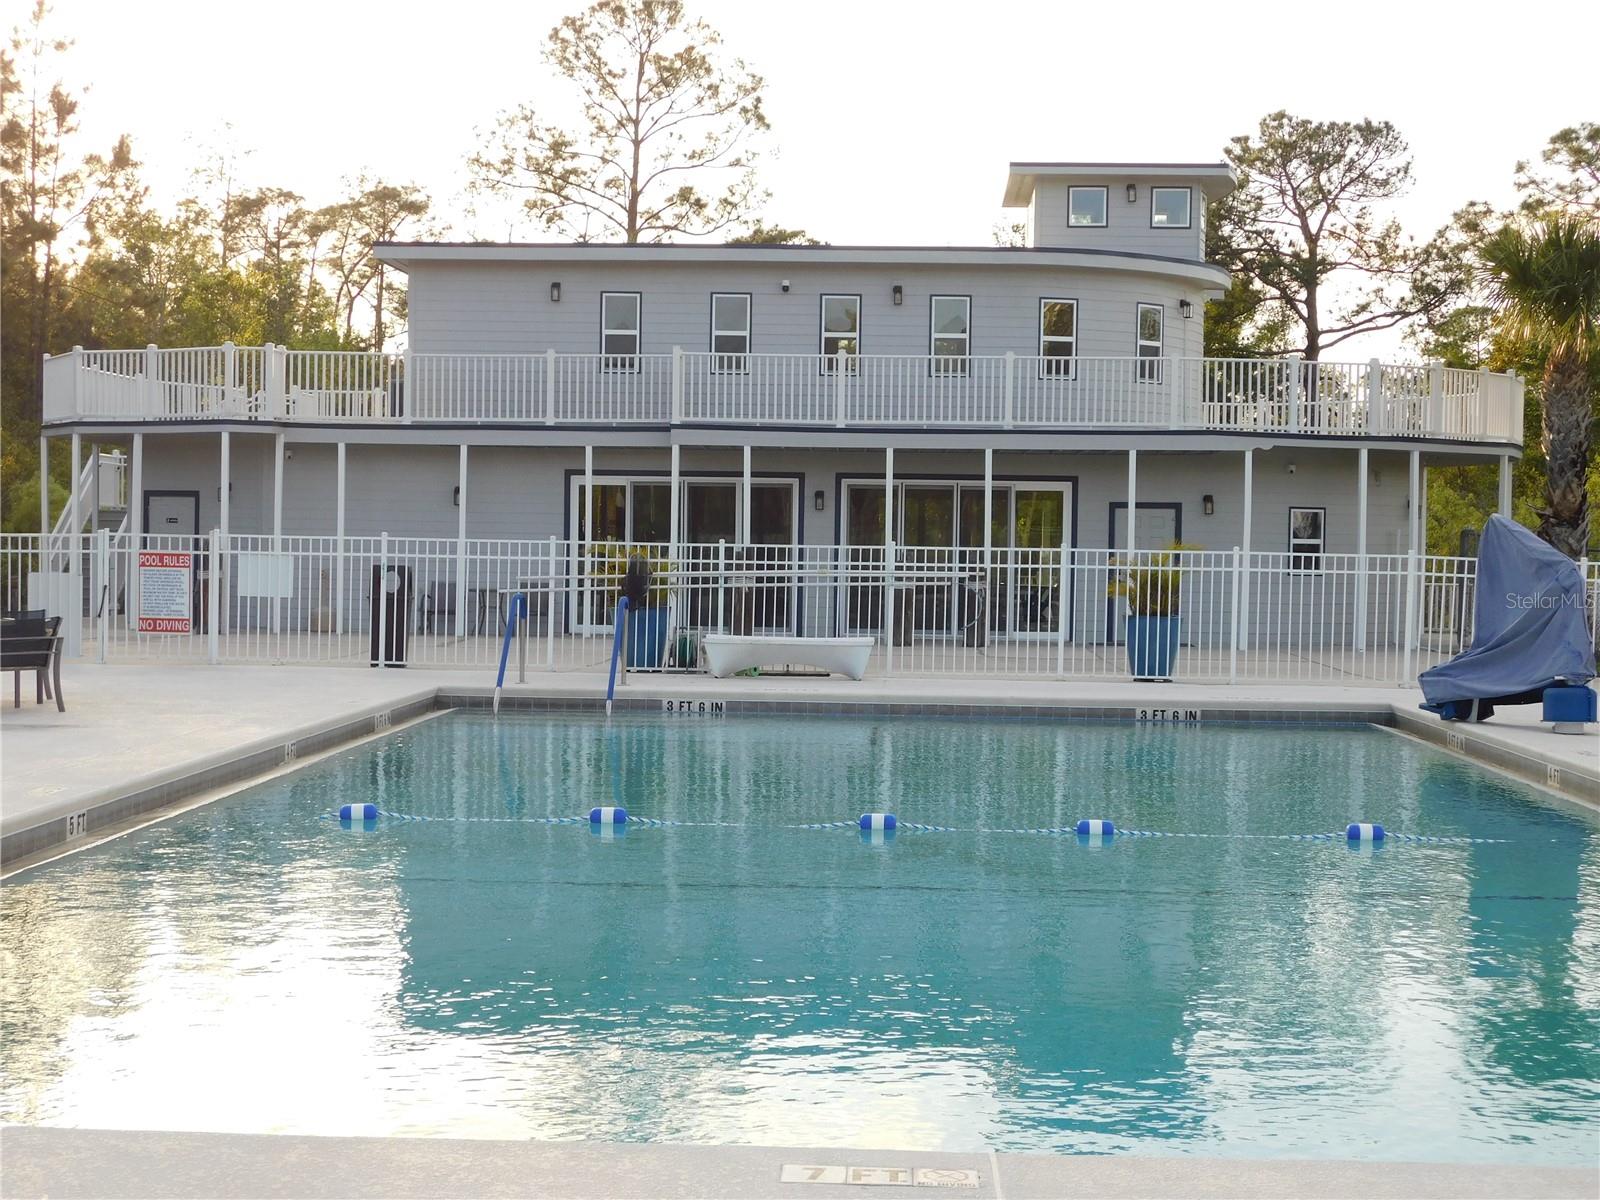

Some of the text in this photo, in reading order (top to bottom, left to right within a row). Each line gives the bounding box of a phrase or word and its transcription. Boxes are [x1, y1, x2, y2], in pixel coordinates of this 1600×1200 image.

[139, 554, 190, 567] POOL RULES
[139, 619, 190, 632] NO DIVING
[666, 700, 723, 713] 3 FT 6 IN
[1140, 709, 1198, 721] 3 FT 6 IN
[69, 812, 86, 836] 5 FT
[802, 1167, 908, 1183] 7 FT
